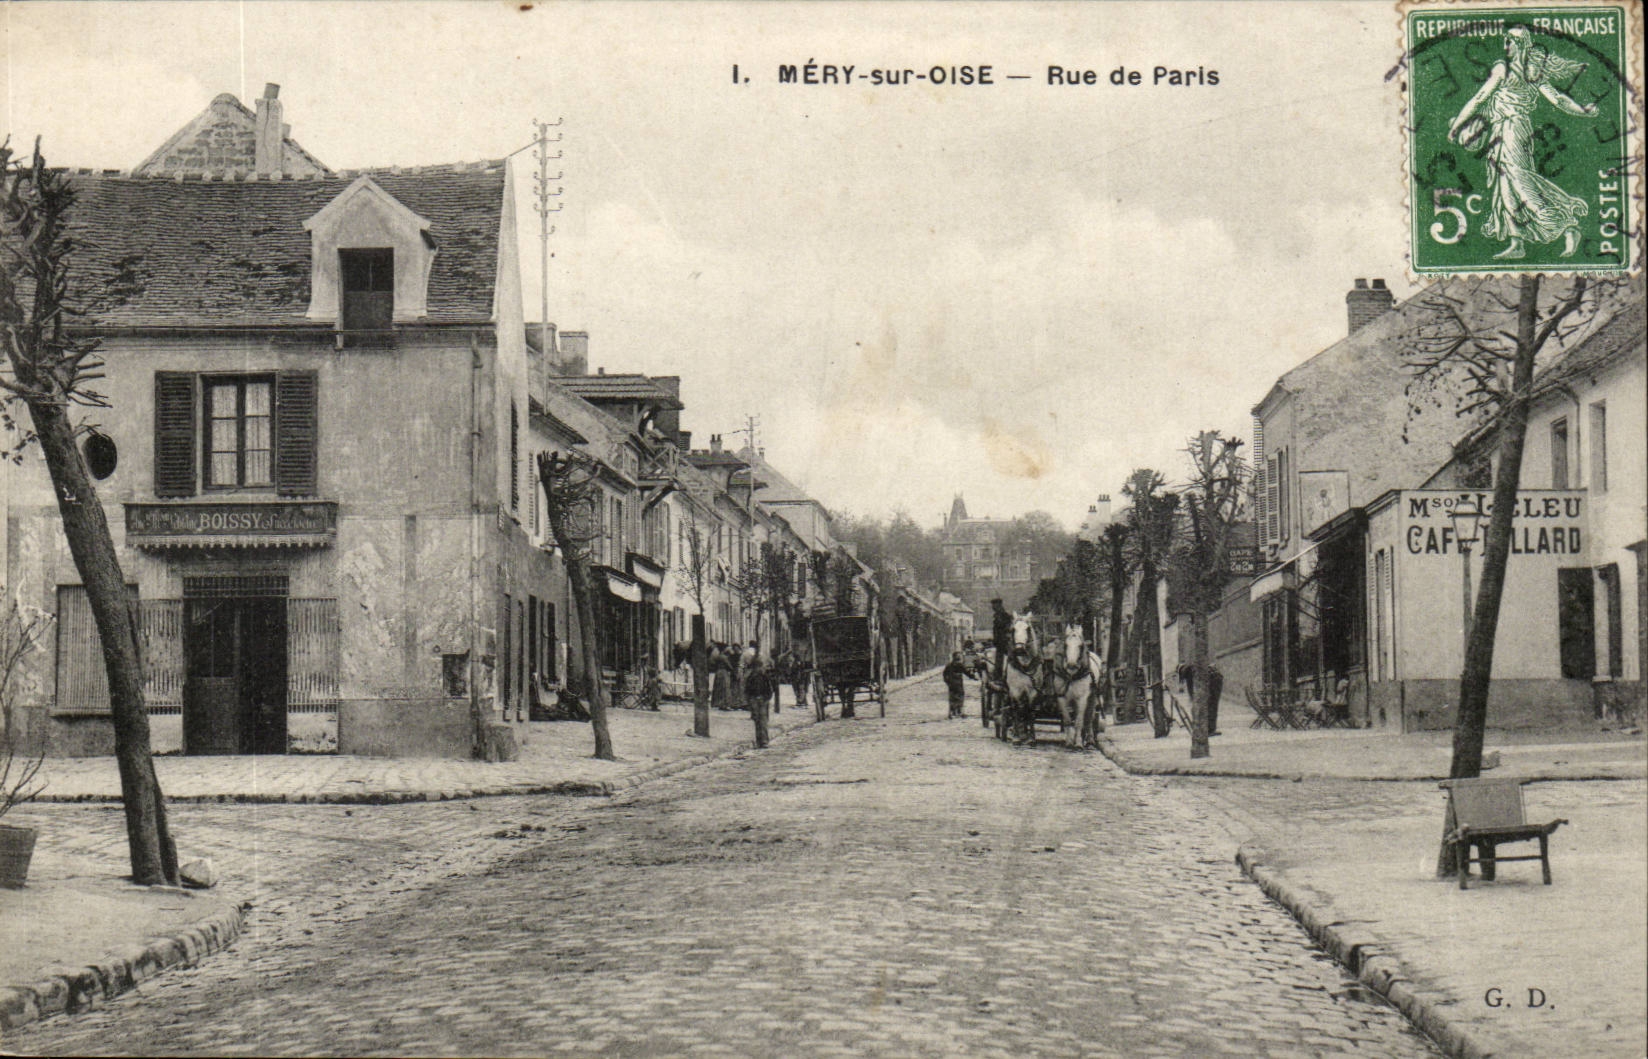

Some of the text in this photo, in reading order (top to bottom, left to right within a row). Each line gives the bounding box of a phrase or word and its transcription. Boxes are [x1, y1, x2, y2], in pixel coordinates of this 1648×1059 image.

[1415, 16, 1616, 38] REPUBLIQUE FRANÇAISE
[1598, 167, 1619, 254] POSTES
[199, 512, 262, 529] BOISSY
[1480, 524, 1581, 557] LLARD
